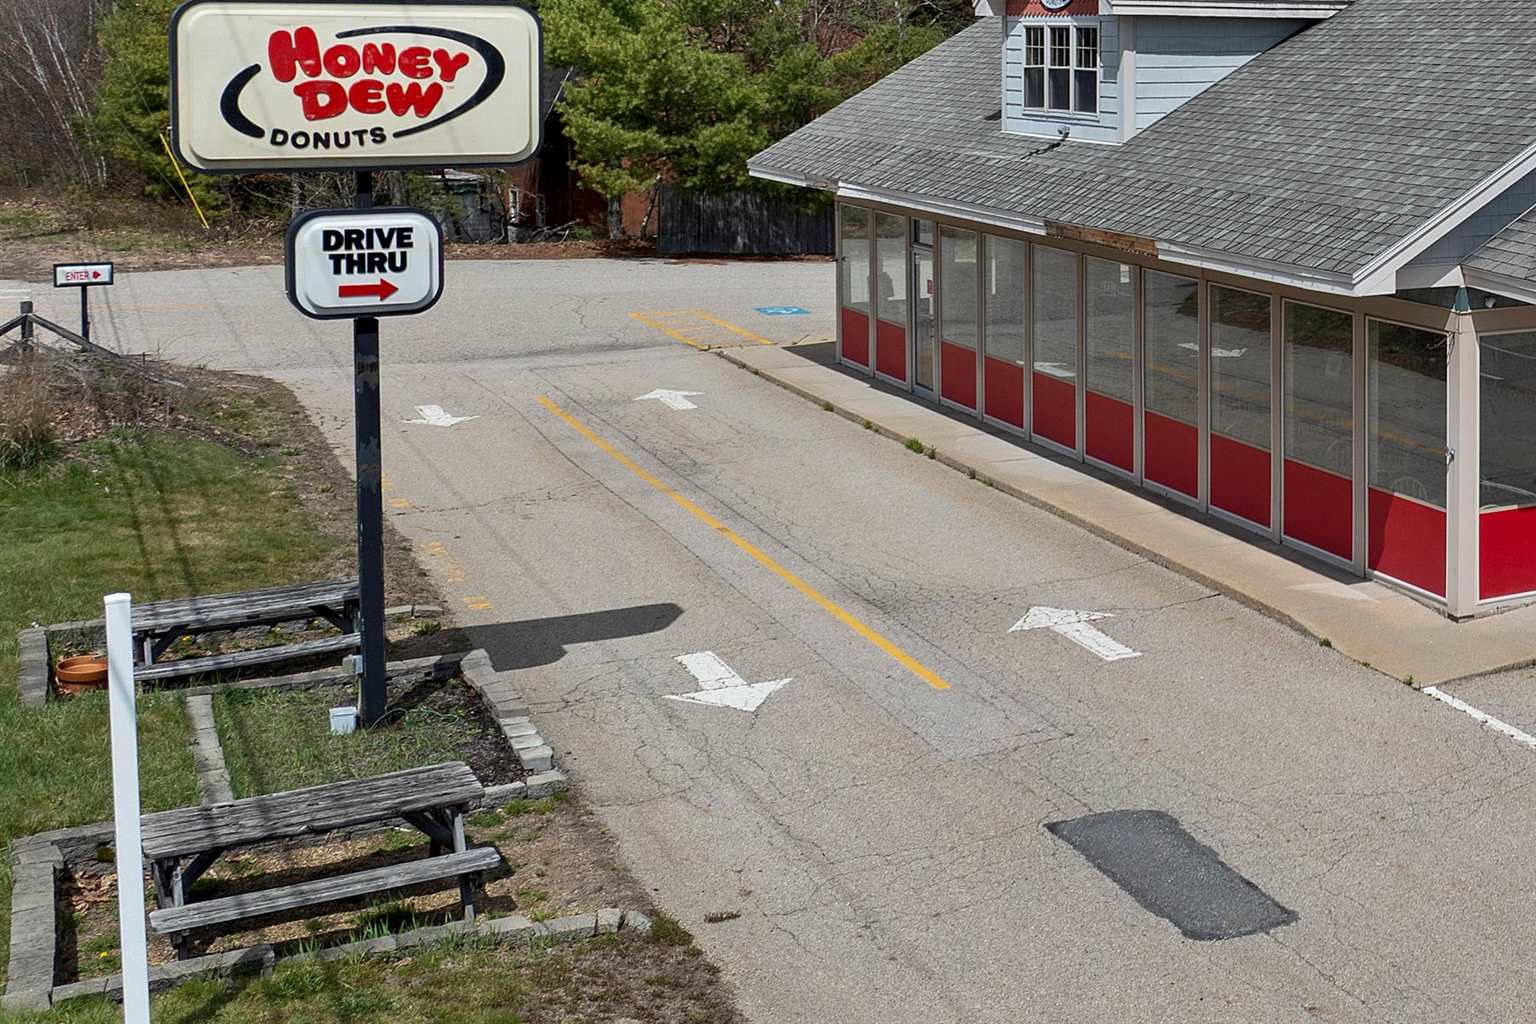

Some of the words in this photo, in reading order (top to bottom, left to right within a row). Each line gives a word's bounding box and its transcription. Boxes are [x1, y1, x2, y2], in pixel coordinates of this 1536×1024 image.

[268, 26, 470, 82] HONEY
[293, 79, 444, 121] DEW
[270, 127, 387, 149] DONUTS
[322, 227, 414, 252] DRIVE
[329, 251, 408, 275] THRU
[65, 271, 89, 281] ENTER
